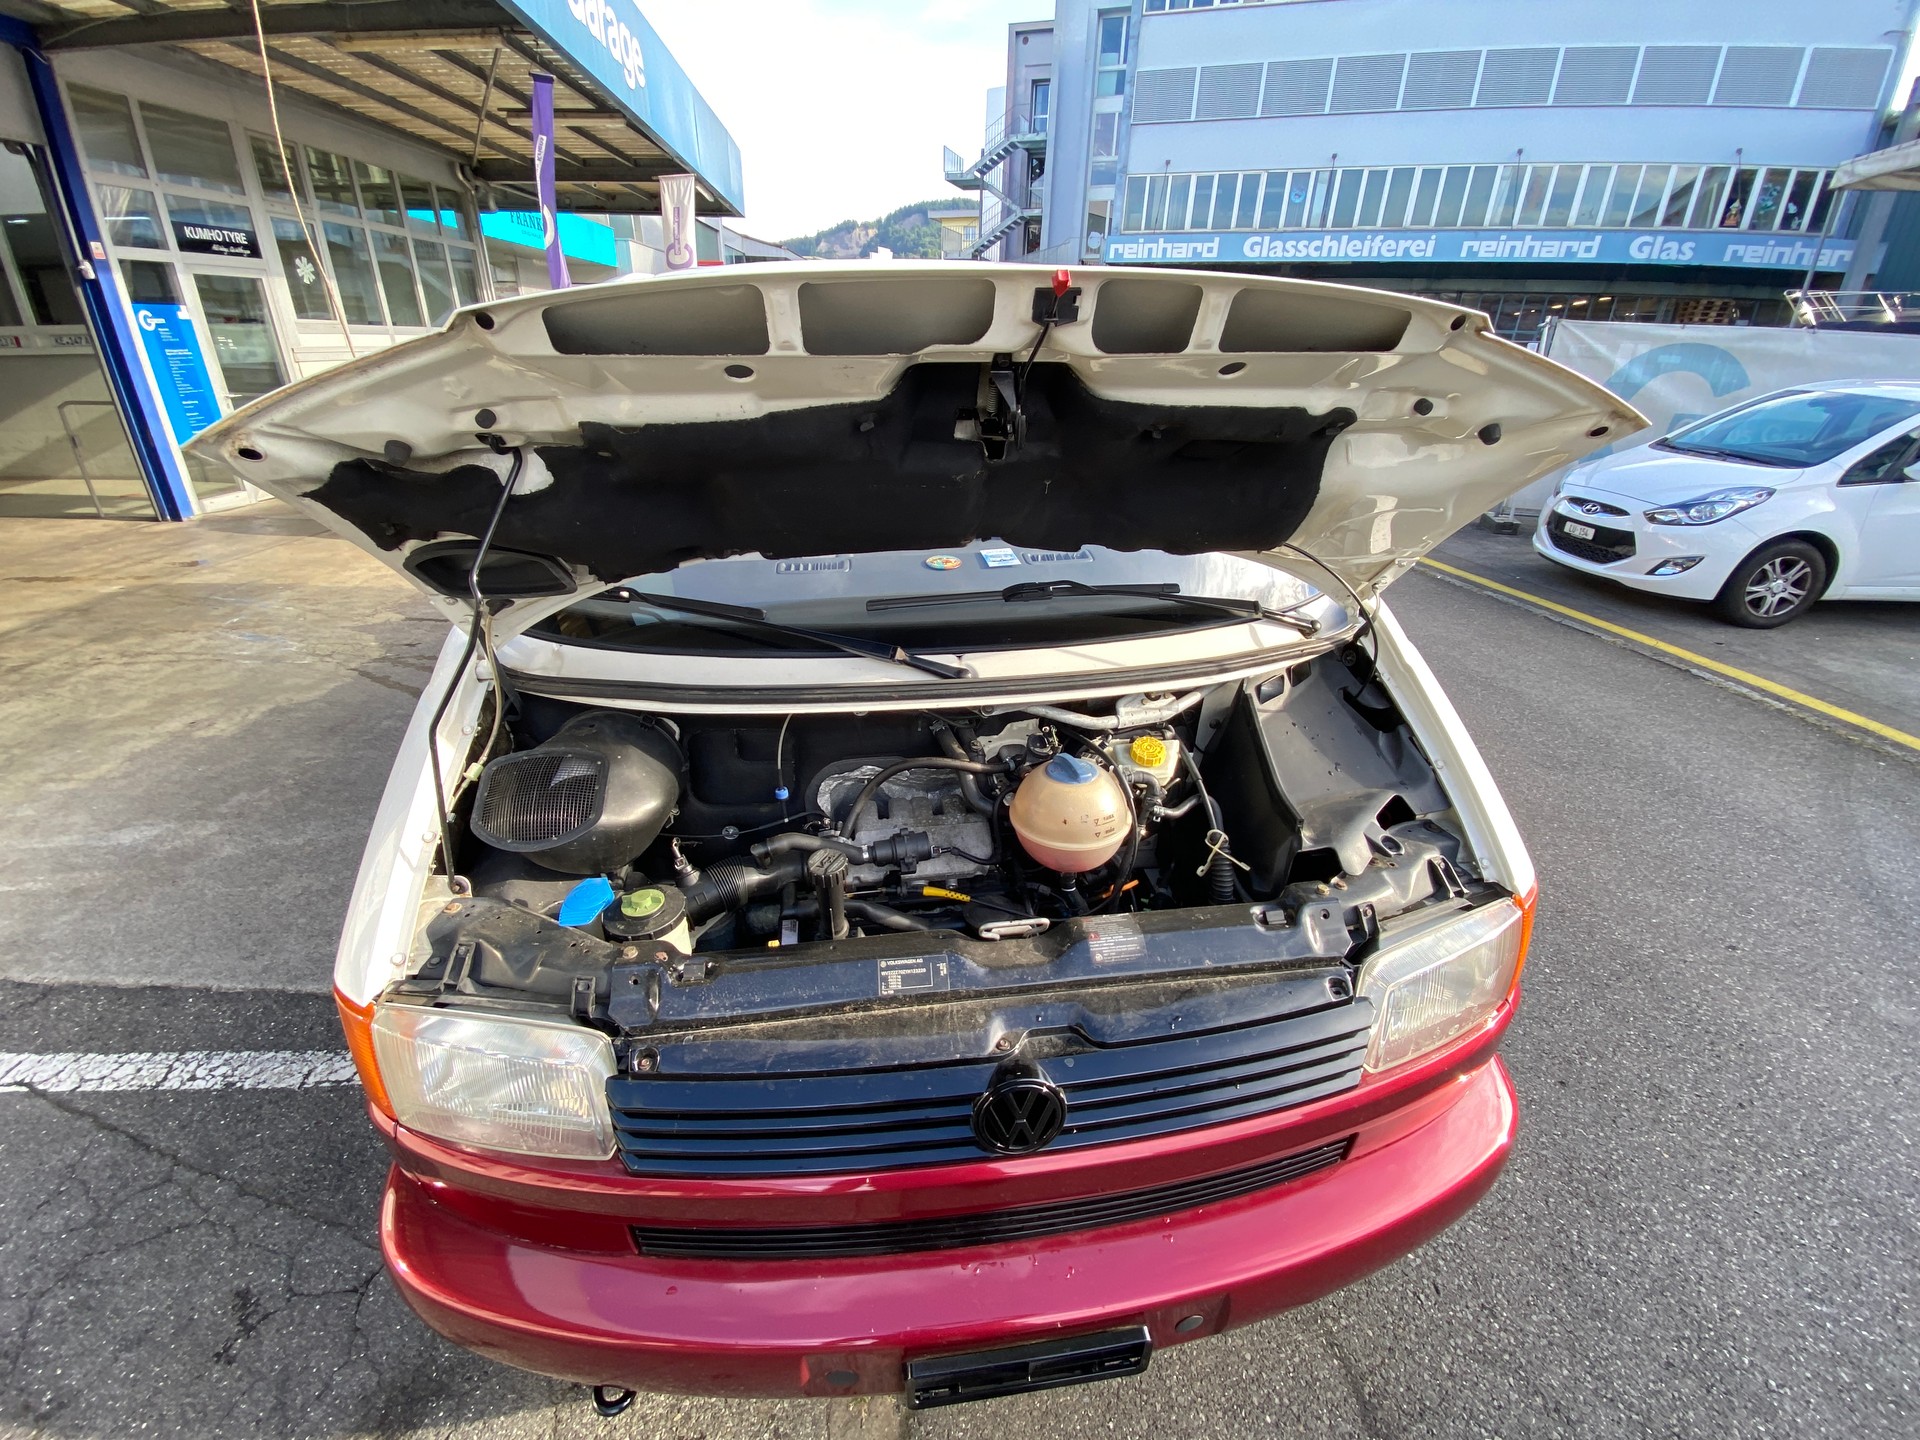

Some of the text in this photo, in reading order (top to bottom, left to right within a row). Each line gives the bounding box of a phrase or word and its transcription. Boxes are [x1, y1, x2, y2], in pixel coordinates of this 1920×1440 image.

[184, 226, 248, 245] KUMHO TYRE
[1109, 234, 1854, 267] reinhard Glasschleiferei reinhard Glas reinhar
